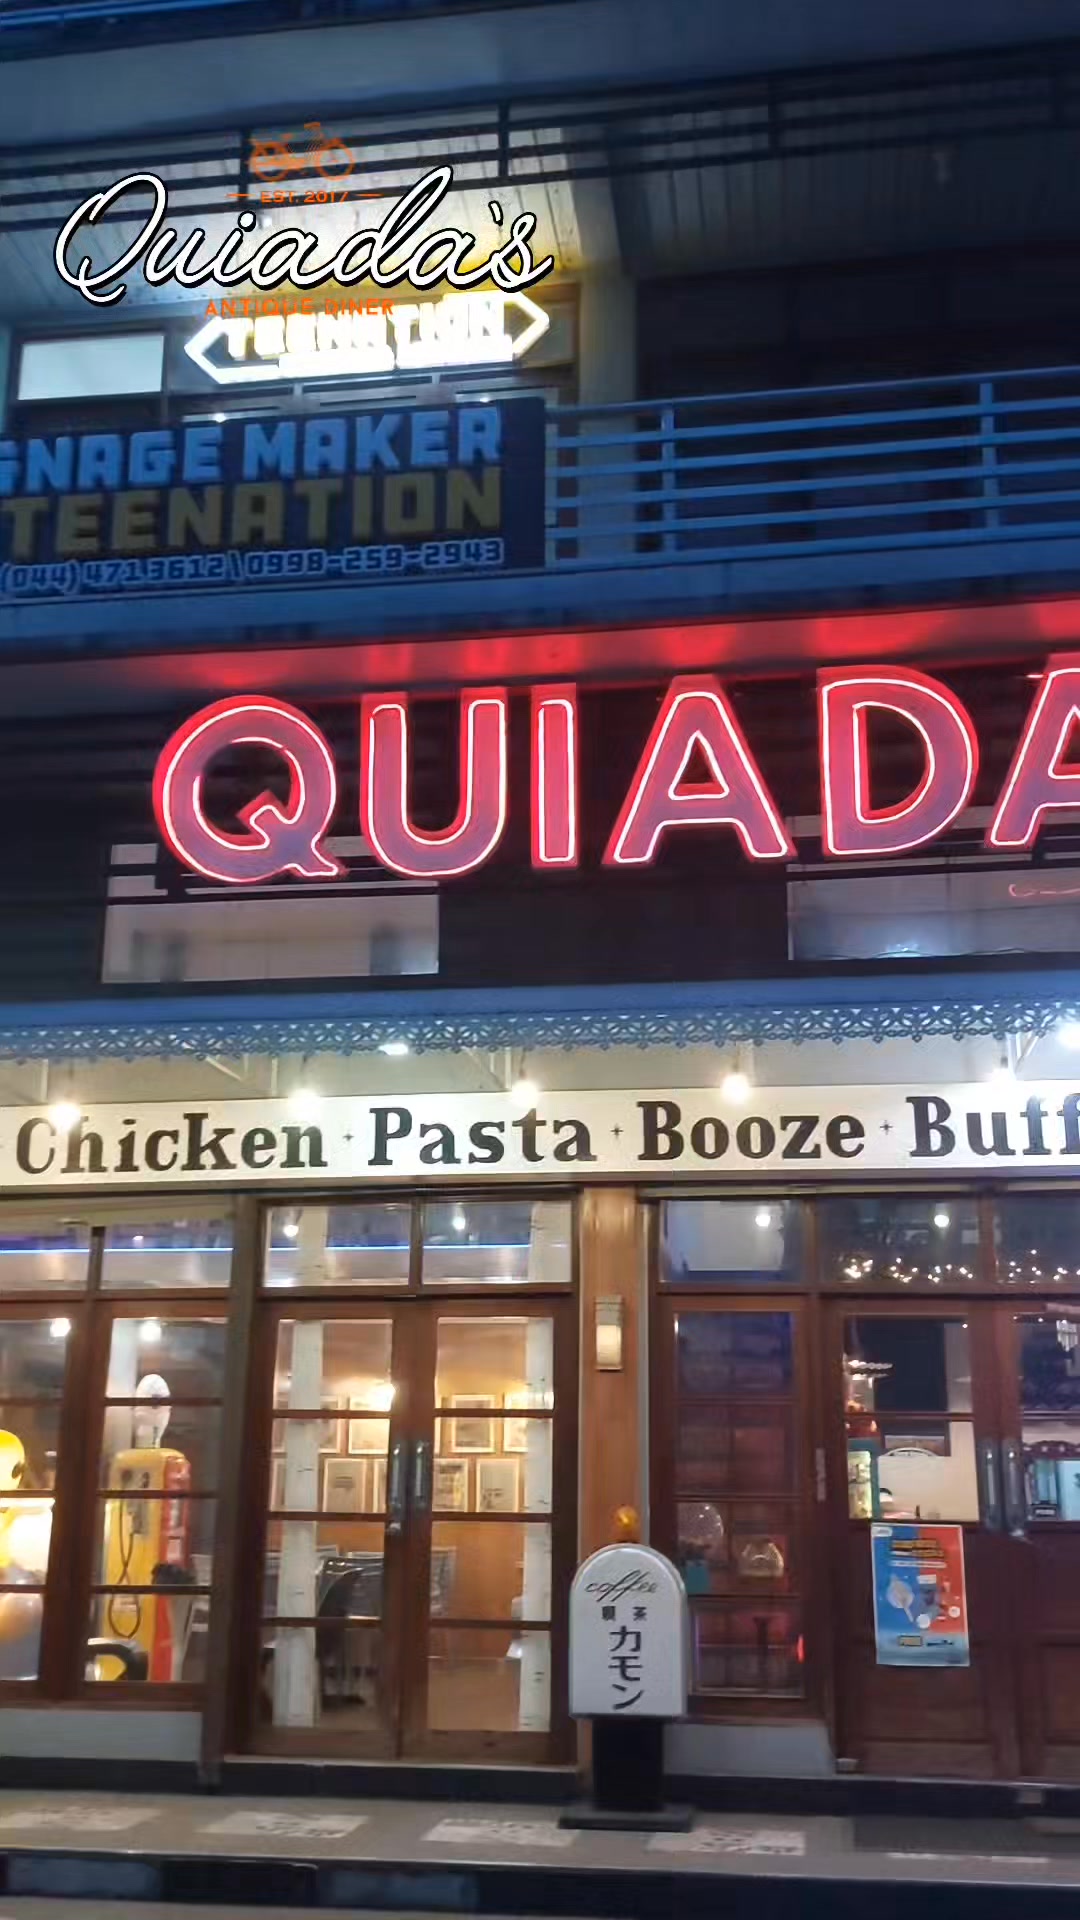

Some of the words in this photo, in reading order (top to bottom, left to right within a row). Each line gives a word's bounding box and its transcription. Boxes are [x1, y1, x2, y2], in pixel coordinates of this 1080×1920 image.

[242, 406, 501, 481] MAKER
[0, 466, 501, 560] TEENATION
[16, 1112, 328, 1175] Chicken
[367, 1106, 598, 1166] Pasta
[636, 1101, 866, 1162] Booze
[585, 1569, 658, 1602] coffee
[608, 1625, 644, 1710] カモン
